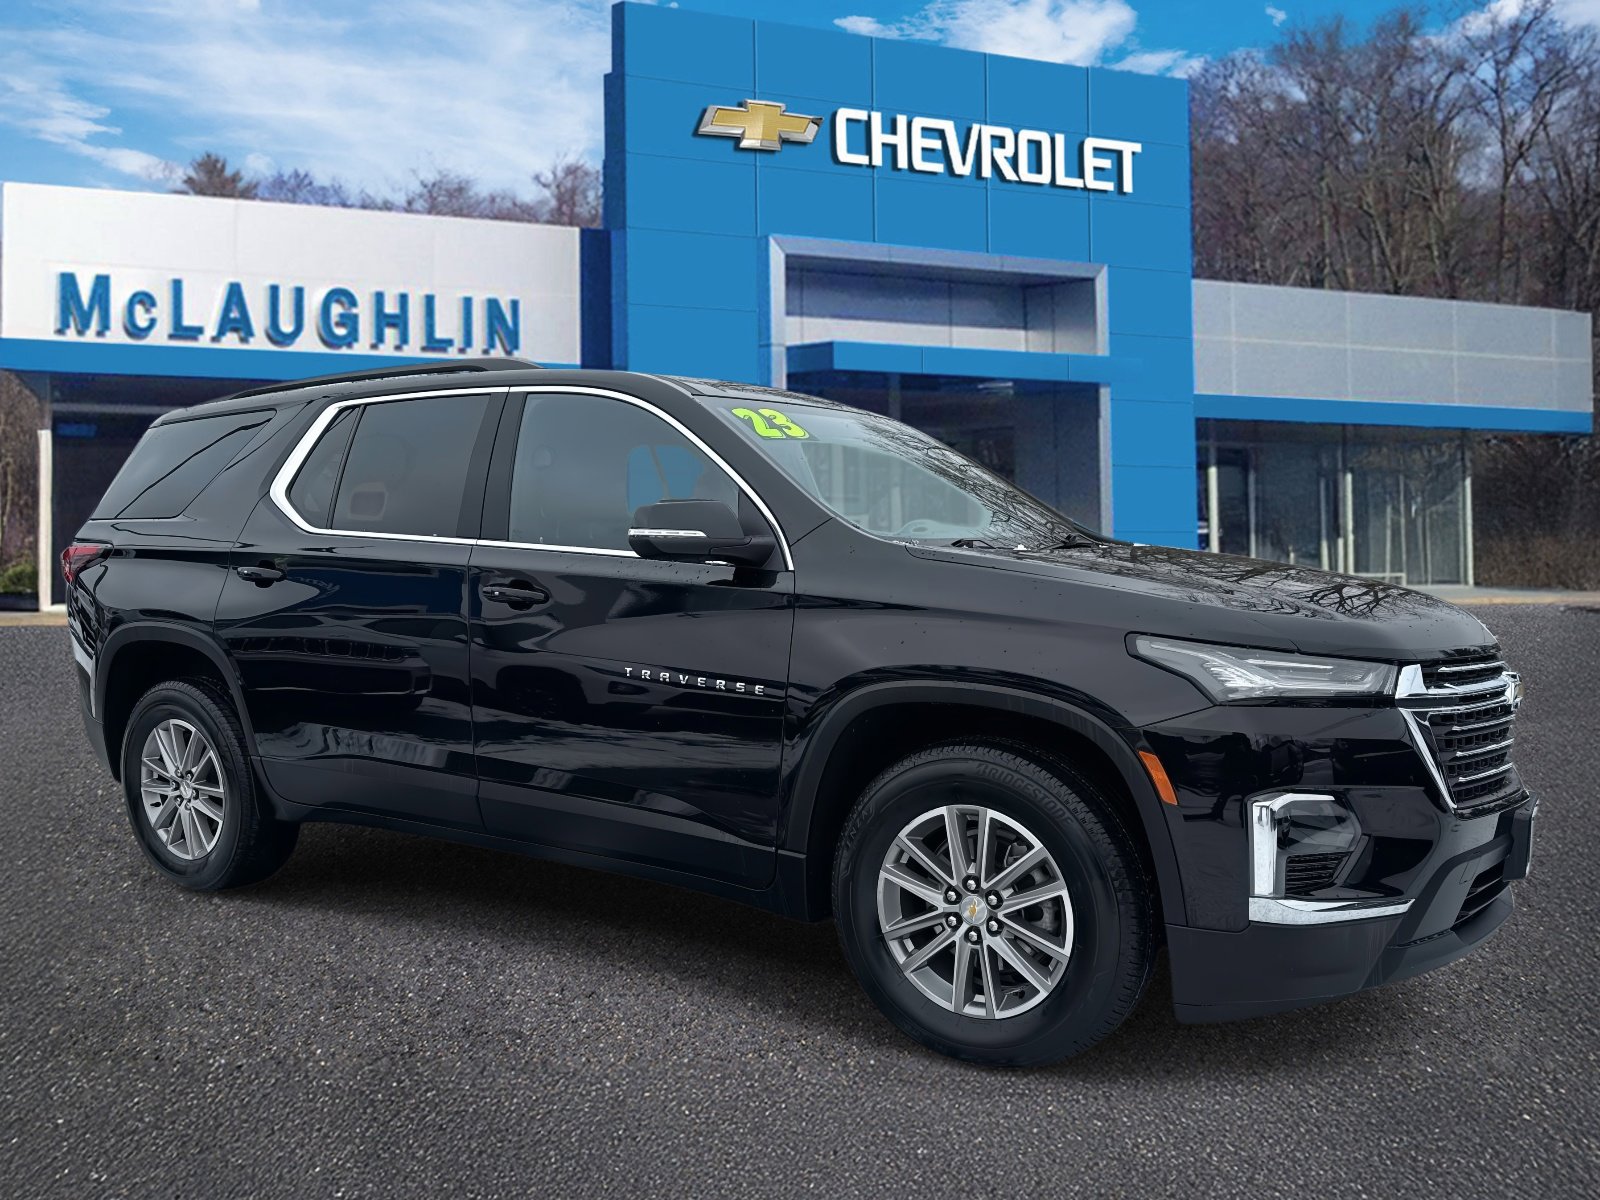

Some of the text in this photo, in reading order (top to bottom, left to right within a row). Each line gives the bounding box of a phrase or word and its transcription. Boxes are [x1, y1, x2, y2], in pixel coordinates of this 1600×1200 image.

[835, 107, 1142, 194] CHEVROLET
[56, 272, 521, 354] McLAUGHLIN
[732, 408, 809, 440] 23
[624, 667, 765, 695] TRAVERSE
